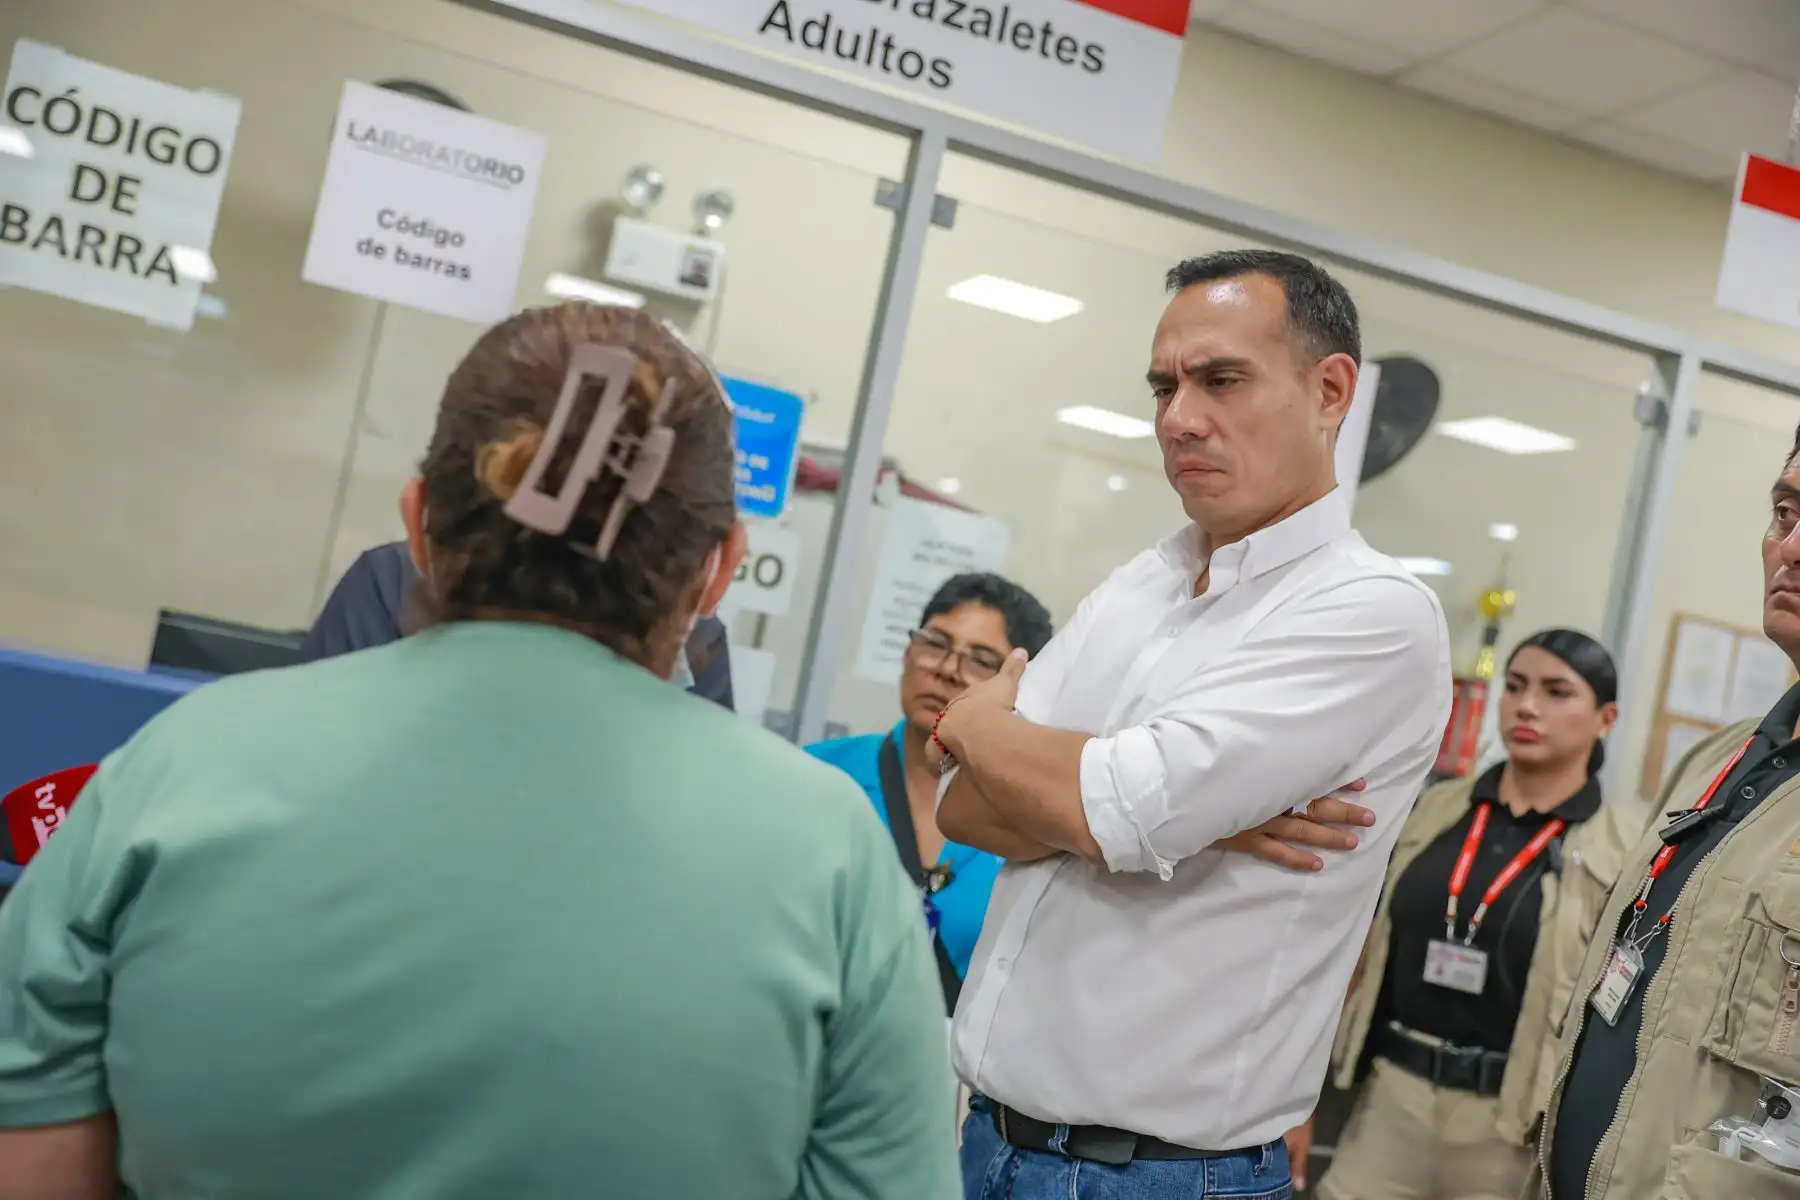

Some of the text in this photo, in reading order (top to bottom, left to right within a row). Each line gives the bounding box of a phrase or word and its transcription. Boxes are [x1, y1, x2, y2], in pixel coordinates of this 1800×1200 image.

[759, 0, 954, 89] Adultos
[857, 0, 1106, 73] azaletes
[7, 86, 221, 175] CÓDIGO
[346, 122, 525, 184] LABORATORIO
[69, 163, 141, 216] DE
[0, 203, 178, 286] BARRA
[356, 238, 472, 281] de barras
[377, 207, 466, 248] Código
